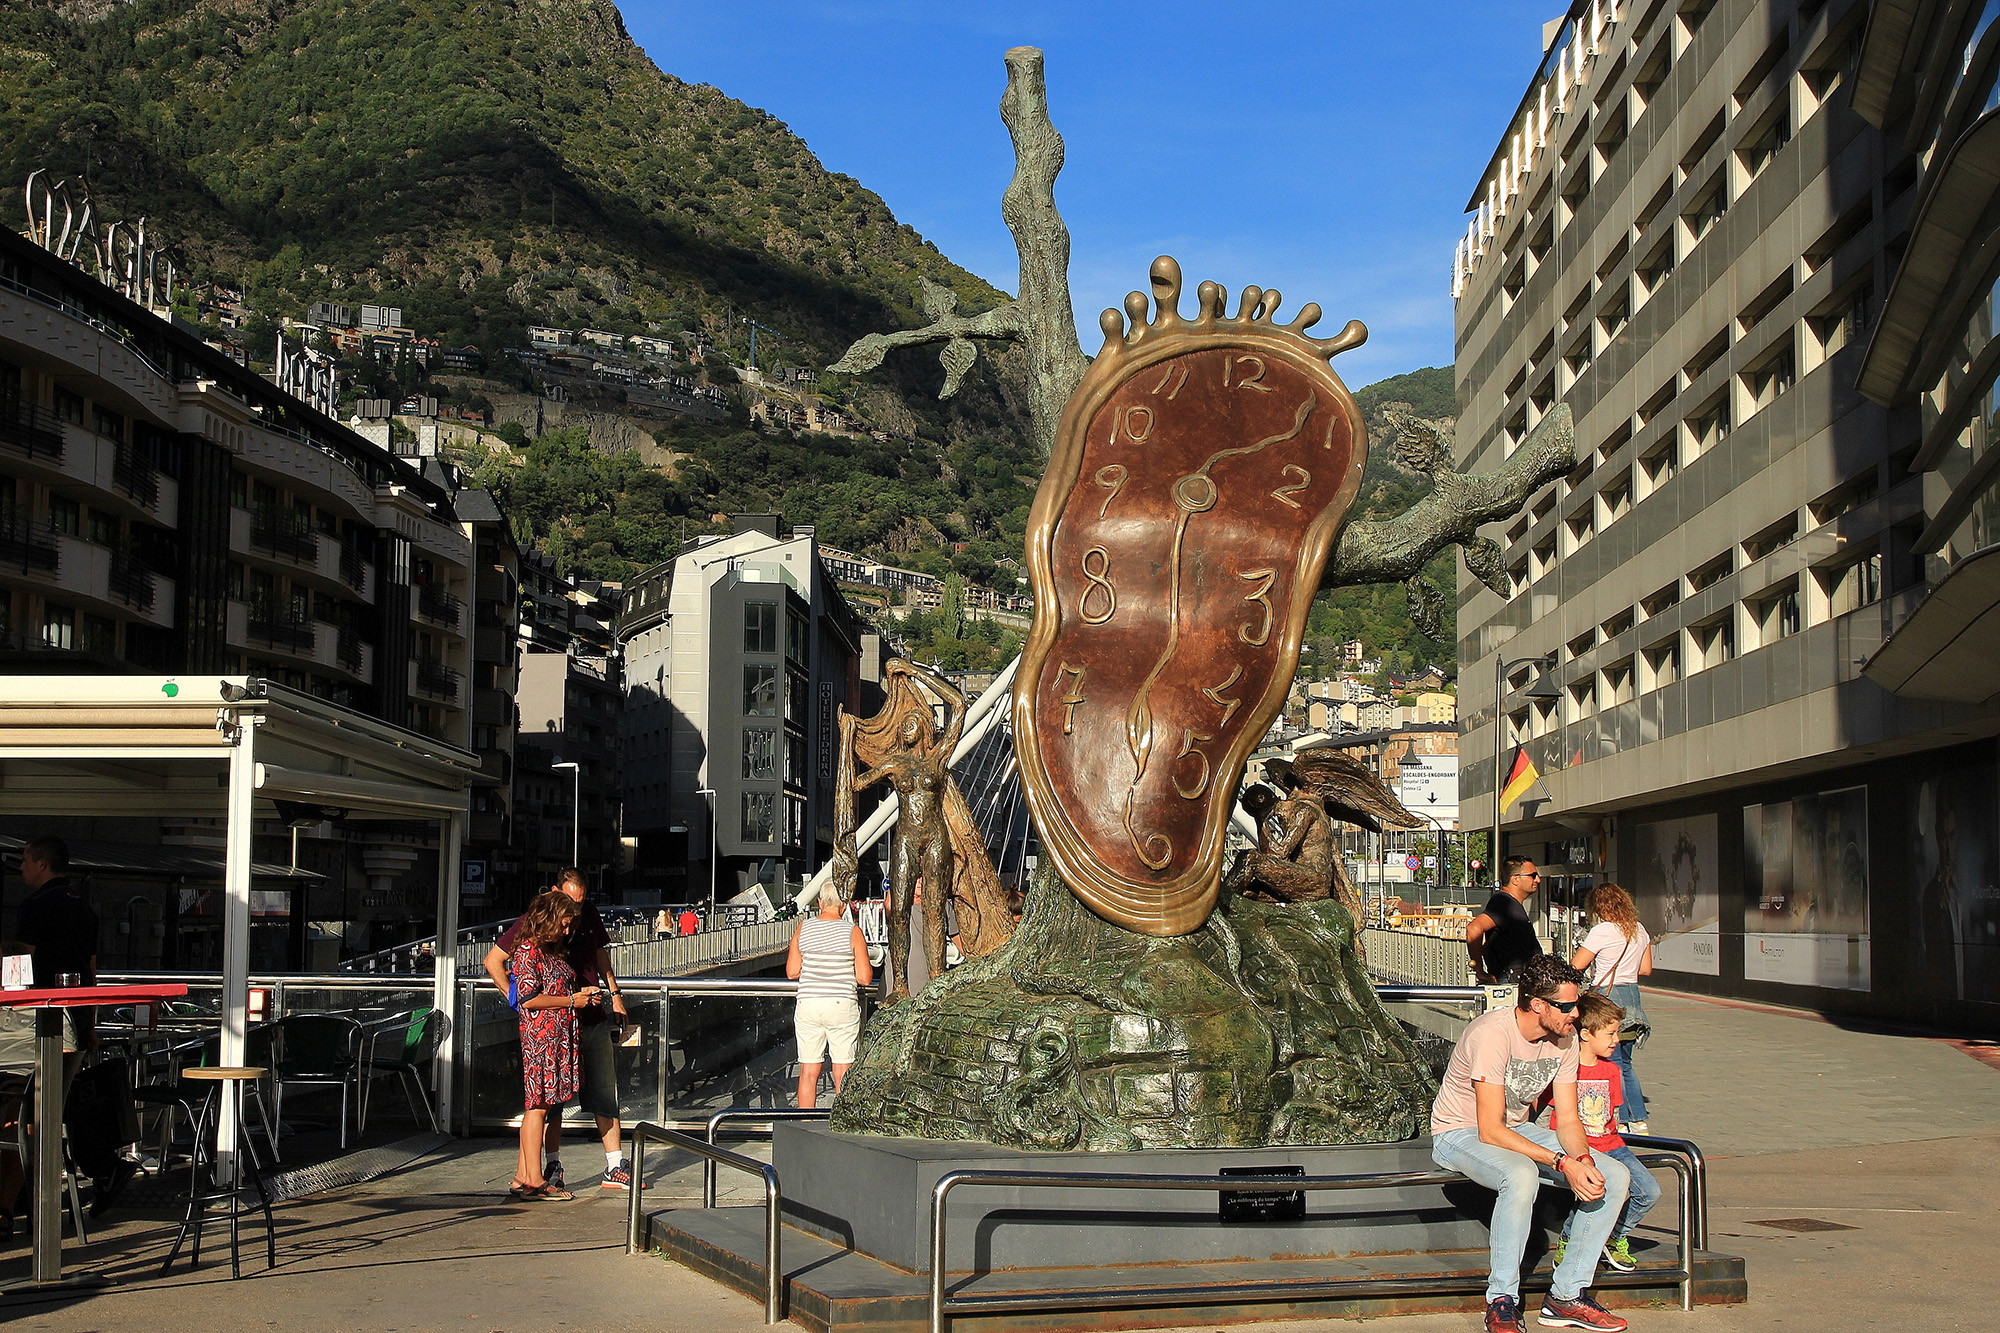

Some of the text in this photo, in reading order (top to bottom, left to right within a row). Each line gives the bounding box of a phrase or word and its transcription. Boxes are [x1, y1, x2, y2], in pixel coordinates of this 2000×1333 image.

[1224, 356, 1272, 391] 12
[1109, 405, 1154, 445] 10
[1324, 415, 1337, 450] 1
[1095, 464, 1129, 518] 9
[1271, 464, 1311, 508] 2
[1078, 545, 1116, 624] 8
[1238, 567, 1279, 647] 3
[821, 684, 831, 719] HOTEL
[1052, 661, 1086, 735] 7
[820, 727, 830, 777] PEDRERA
[1172, 727, 1213, 800] 5
[466, 864, 482, 881] P
